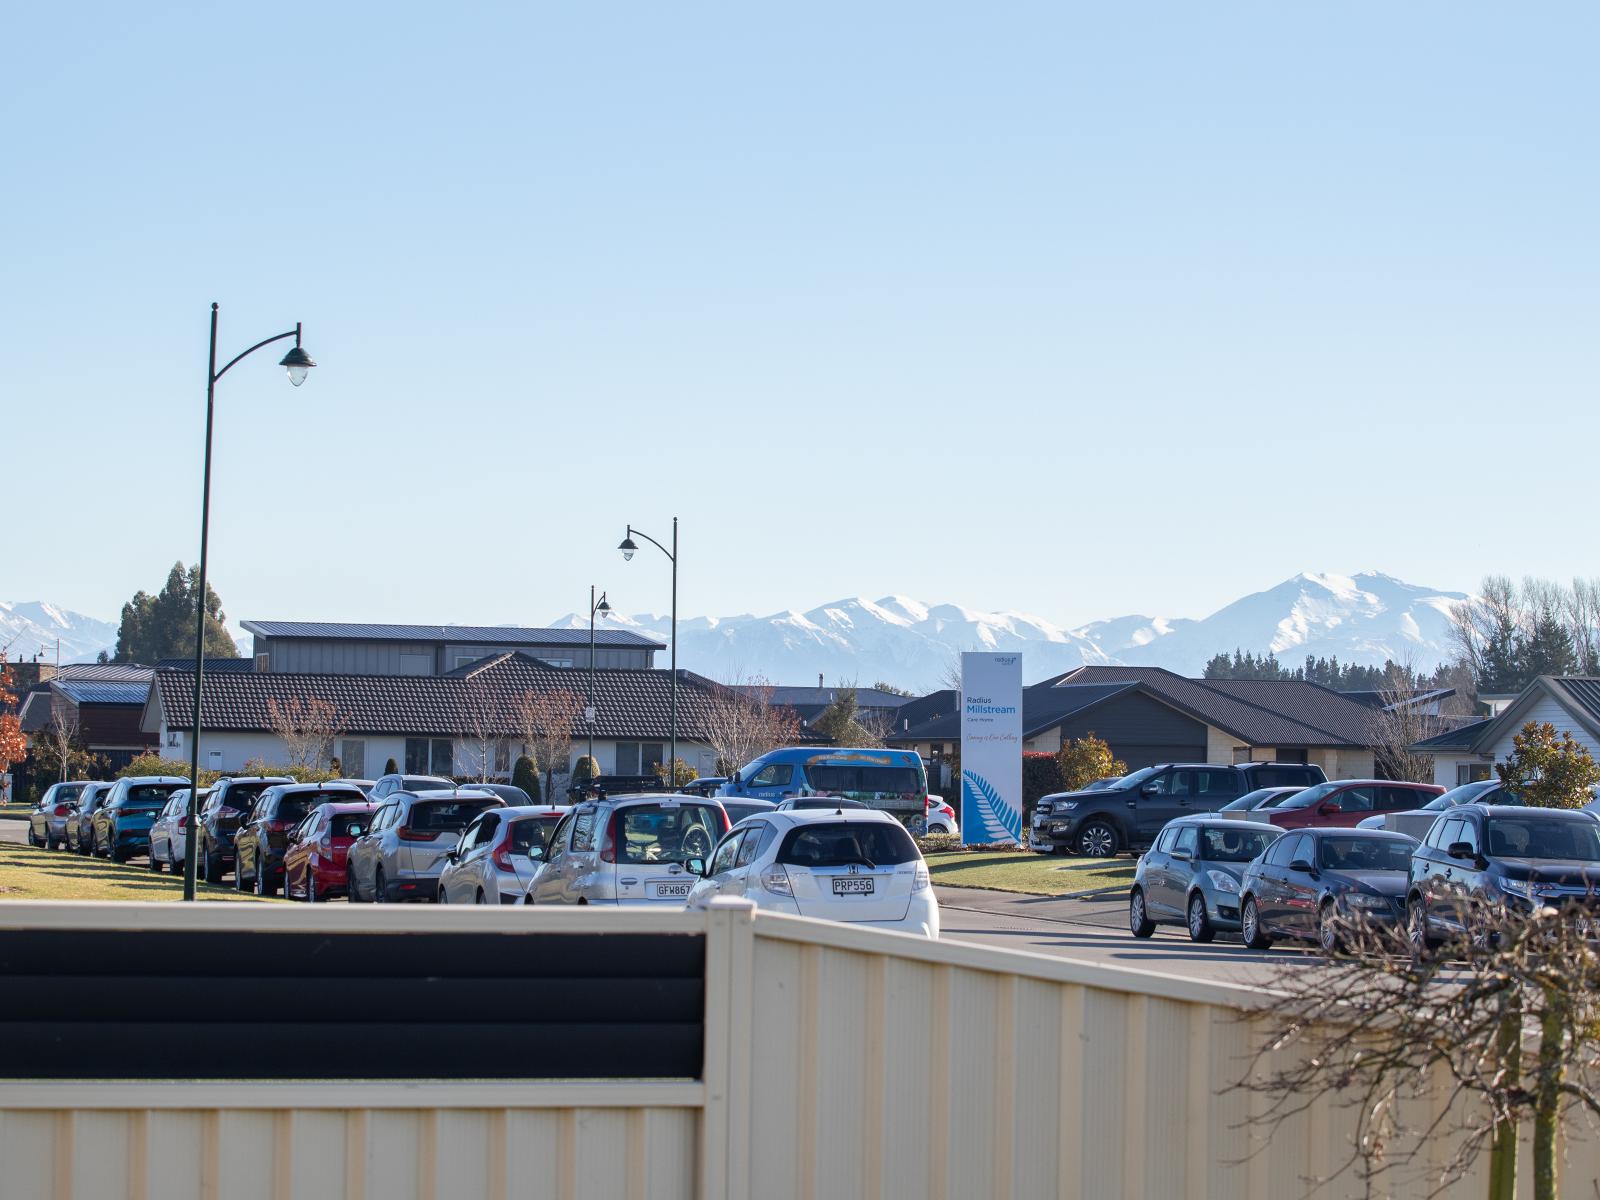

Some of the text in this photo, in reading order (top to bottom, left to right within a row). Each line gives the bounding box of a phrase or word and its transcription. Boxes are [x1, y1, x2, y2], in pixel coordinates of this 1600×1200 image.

[967, 696, 992, 704] Radius
[967, 705, 1016, 714] Millstream
[834, 880, 872, 891] PRP556
